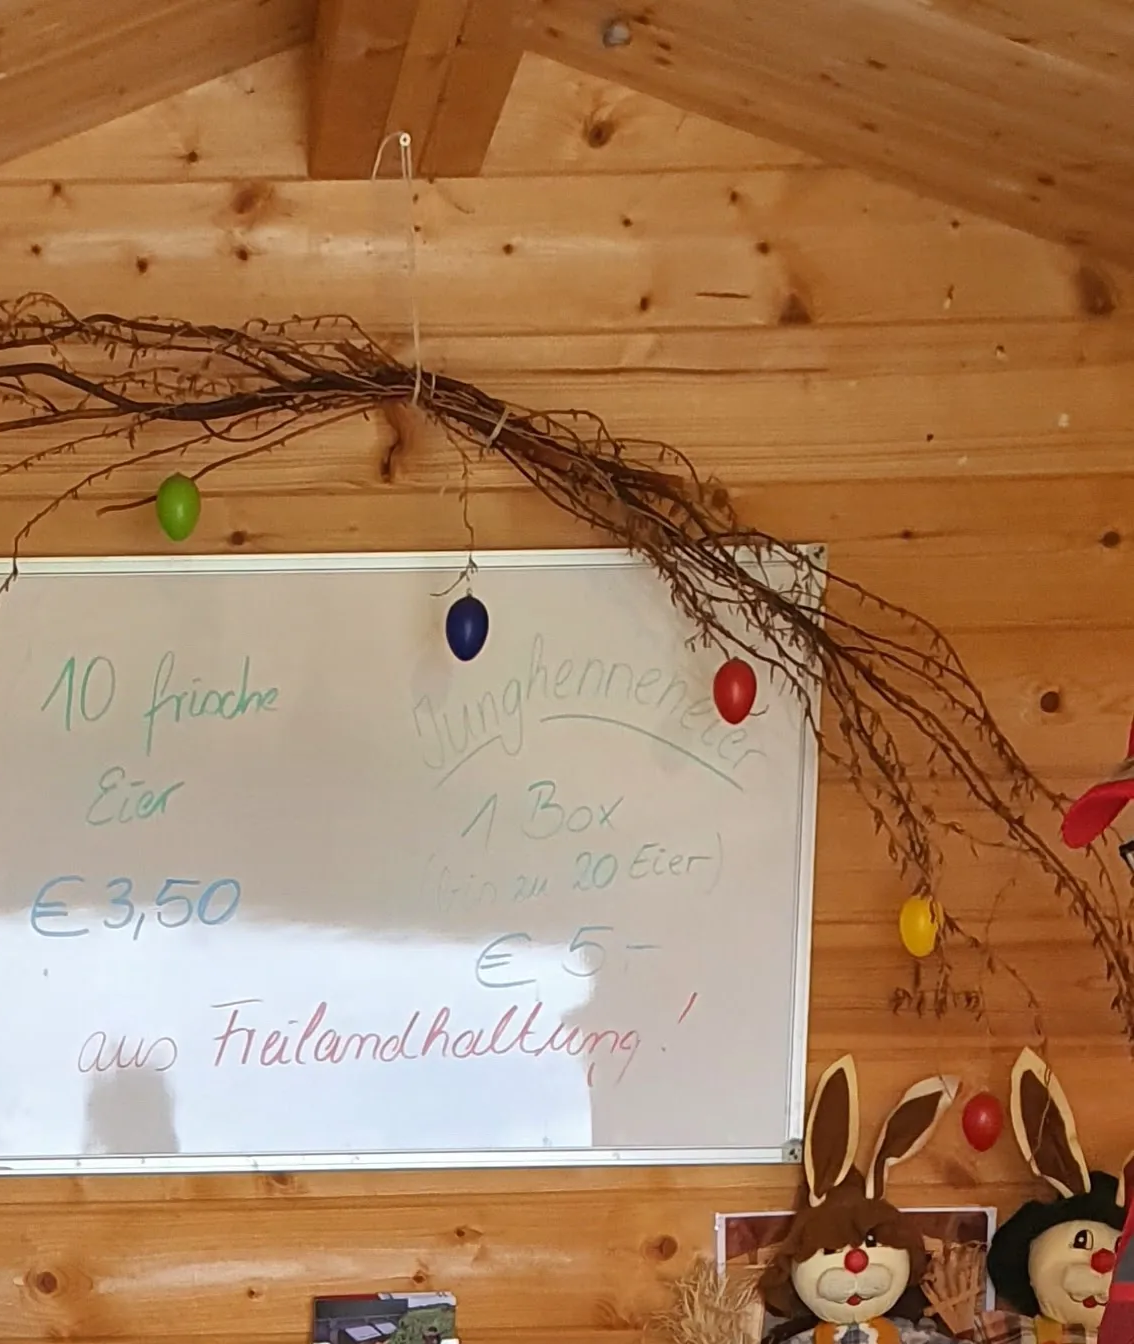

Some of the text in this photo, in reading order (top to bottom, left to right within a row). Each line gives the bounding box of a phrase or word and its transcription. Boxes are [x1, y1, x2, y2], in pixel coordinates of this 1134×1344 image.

[41, 651, 280, 757] 10 frische
[84, 766, 186, 827] Eier
[461, 780, 625, 850] 1 Box
[572, 850, 618, 892] 20
[628, 832, 724, 896] Eier)
[77, 1030, 178, 1073] aus
